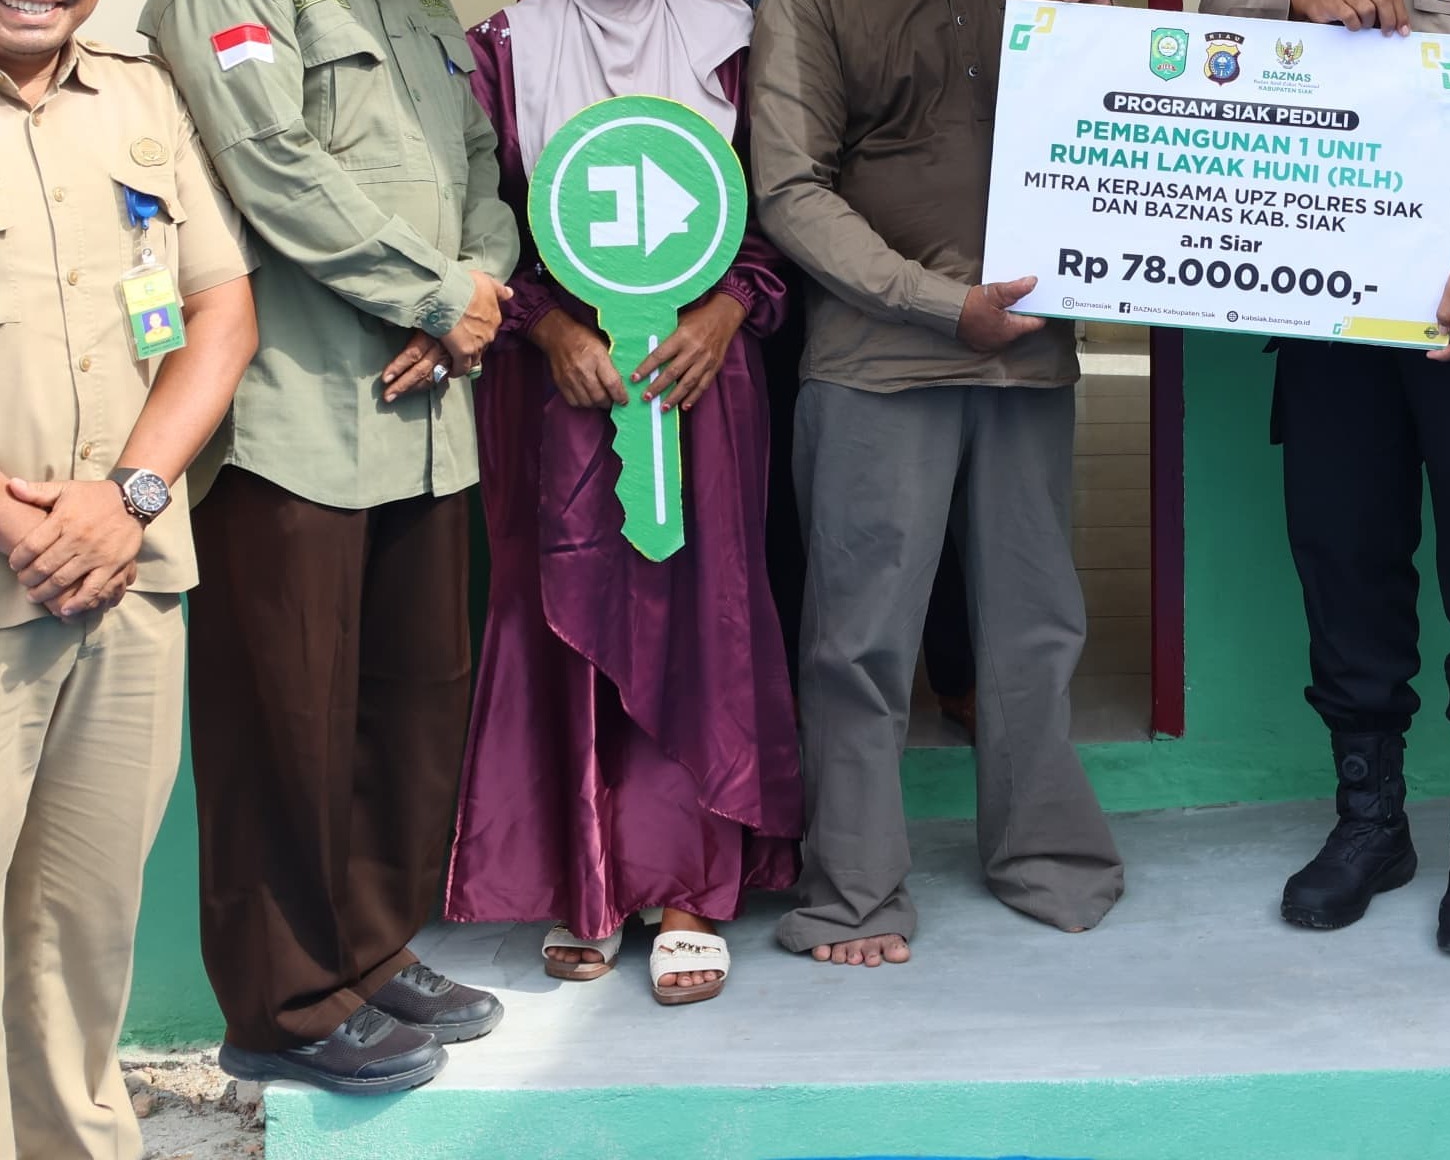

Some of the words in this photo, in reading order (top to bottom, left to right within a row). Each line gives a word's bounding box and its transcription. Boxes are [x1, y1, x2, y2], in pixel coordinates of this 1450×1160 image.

[1258, 85, 1297, 94] KABUPATEN
[1262, 70, 1312, 83] BAZNAS
[1114, 95, 1217, 118] PROGRAM
[1222, 103, 1272, 122] SIAK
[1276, 106, 1350, 128] PEDULI
[1076, 120, 1291, 155] PEMBANGUNAN
[1299, 137, 1309, 157] 1
[1318, 139, 1382, 162] UNIT
[1050, 143, 1149, 170] RUMAH
[1158, 153, 1244, 178] LAYAK
[1253, 160, 1319, 183] HUNI
[1328, 165, 1403, 192] (RLH)
[1024, 171, 1091, 192] MITRA
[1098, 177, 1228, 203] KERJASAMA
[1234, 188, 1277, 207] UPZ
[1284, 192, 1367, 214] POLRES
[1373, 199, 1423, 219] SIAK
[1092, 197, 1138, 216] DAN
[1145, 201, 1234, 223] BAZNAS
[1240, 209, 1290, 228] KAB.
[1296, 214, 1346, 233] SIAK
[1180, 234, 1213, 250] a.n
[1219, 235, 1262, 253] Siar
[1057, 248, 1109, 284] Rp
[1121, 253, 1378, 305] 78.000.000,-
[1075, 300, 1112, 310] baznassiak
[1133, 305, 1161, 314] BAZNAS
[1163, 306, 1200, 317] Kabupaten
[1201, 310, 1216, 318] Siak
